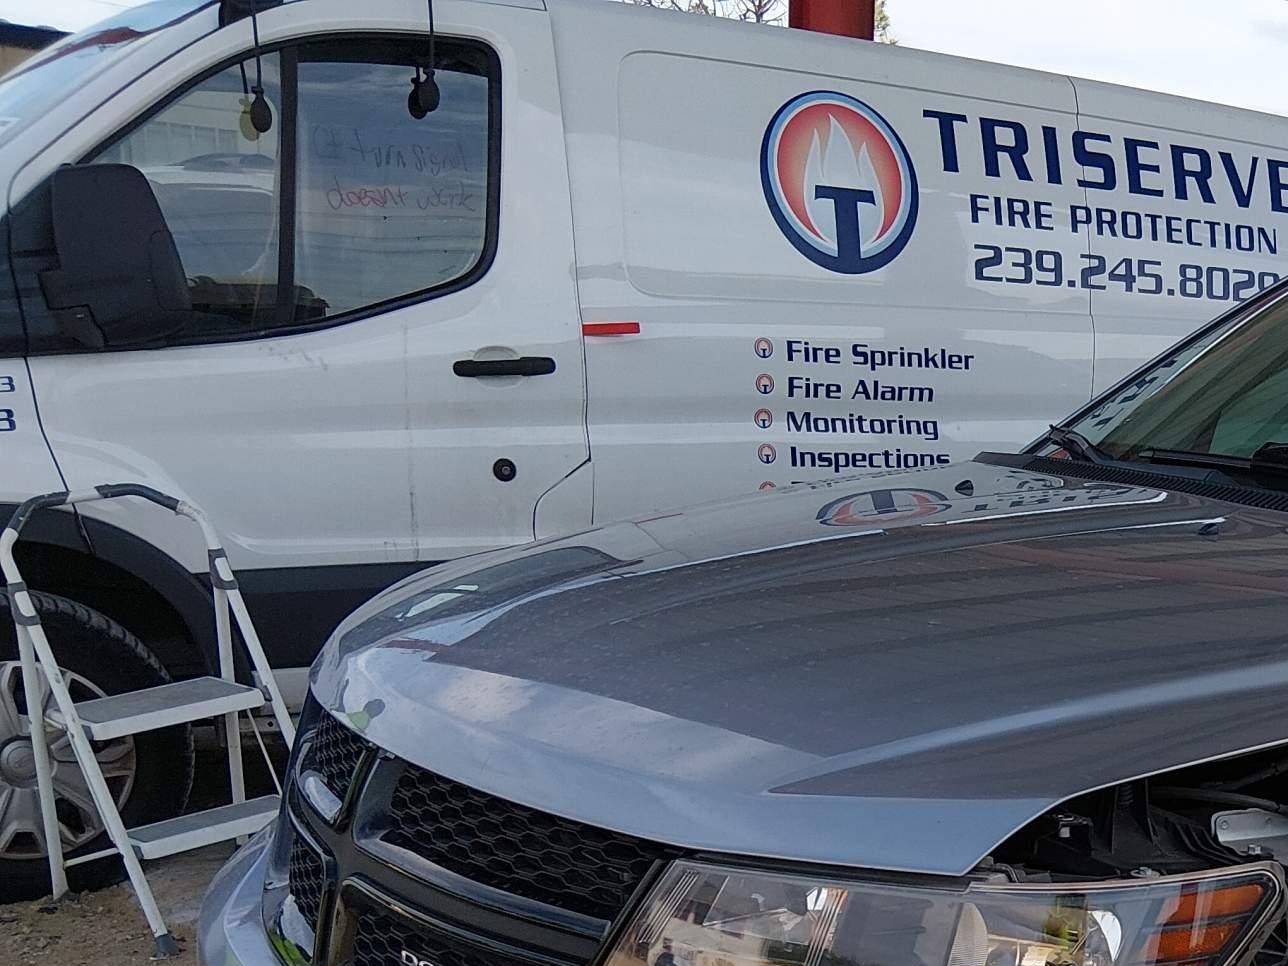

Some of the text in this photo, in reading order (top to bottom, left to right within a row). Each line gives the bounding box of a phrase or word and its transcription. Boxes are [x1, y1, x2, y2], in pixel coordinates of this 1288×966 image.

[969, 194, 1278, 255] FIRE PROTECTION
[786, 340, 975, 371] Fire Sprinkler
[787, 376, 934, 402] Fire Alarm
[786, 411, 939, 441] Monitoring
[789, 446, 951, 473] Inspections
